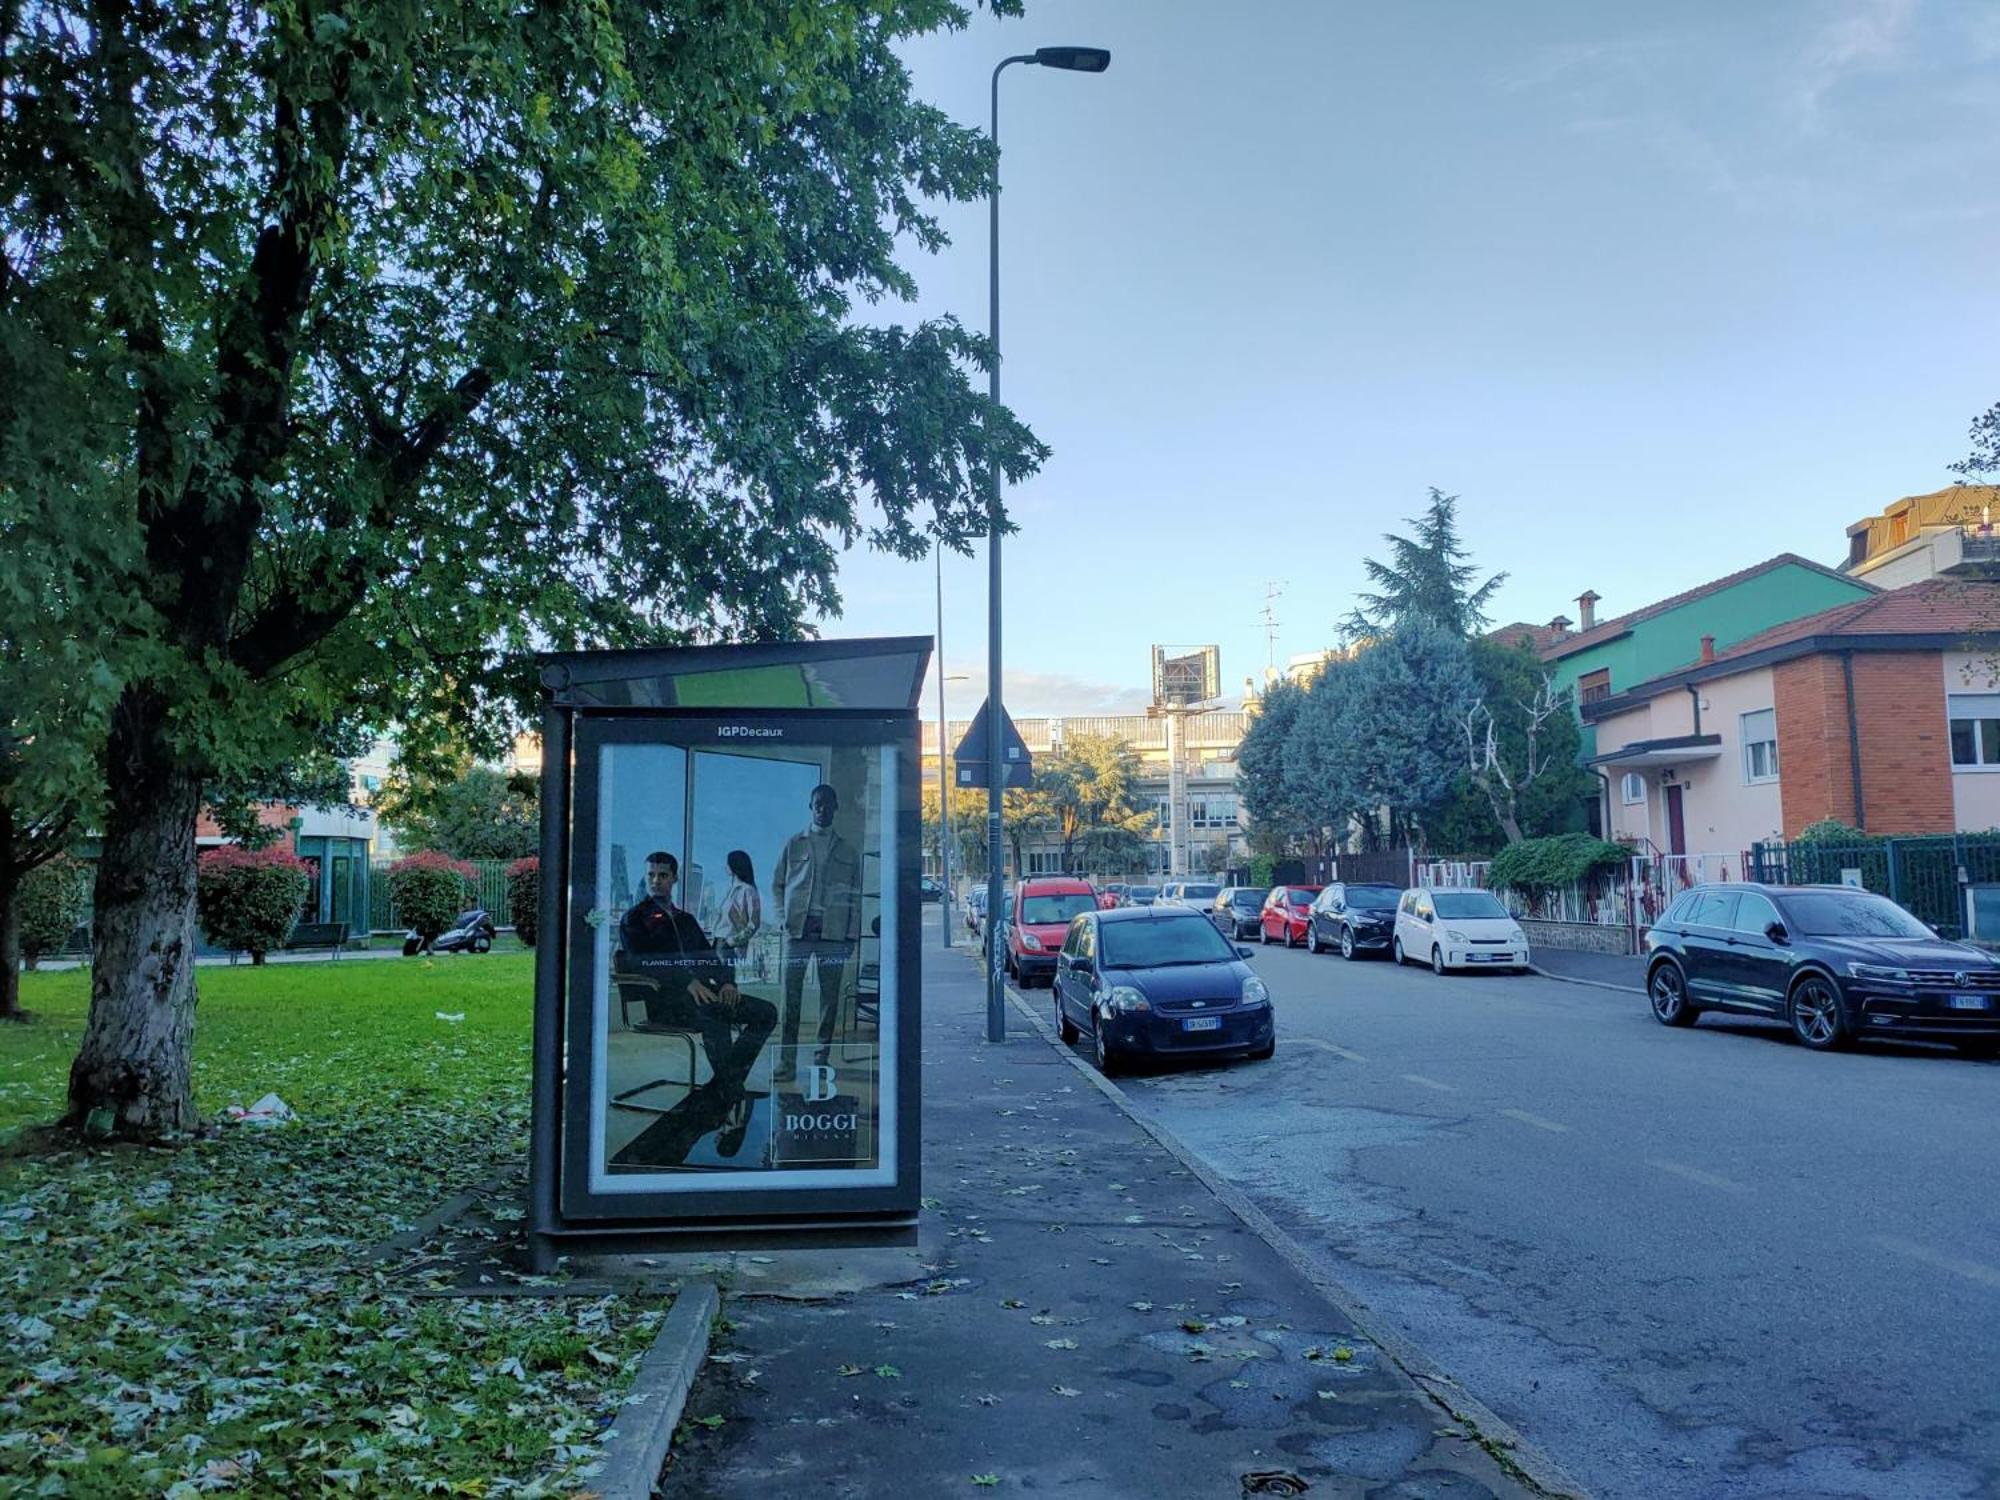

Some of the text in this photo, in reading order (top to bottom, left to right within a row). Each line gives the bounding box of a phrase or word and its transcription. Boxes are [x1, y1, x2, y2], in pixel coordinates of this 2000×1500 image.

[717, 726, 784, 737] IGPDecaux
[805, 1065, 838, 1101] B
[784, 1113, 858, 1131] BOGGI
